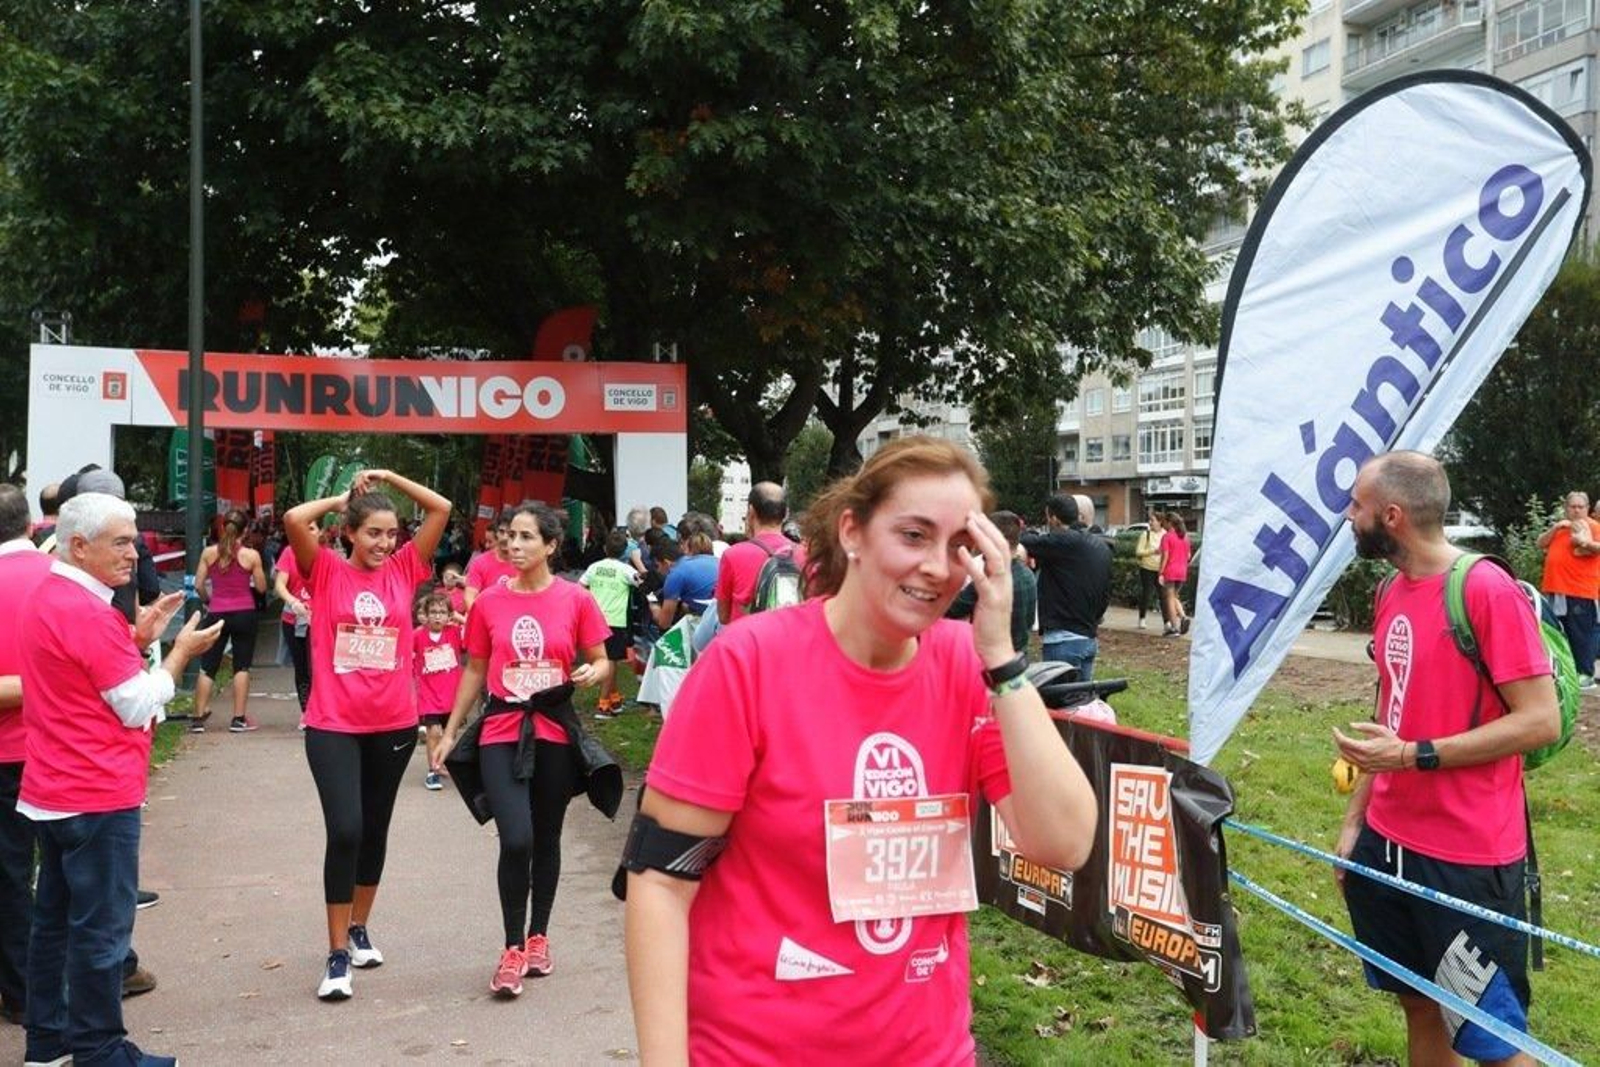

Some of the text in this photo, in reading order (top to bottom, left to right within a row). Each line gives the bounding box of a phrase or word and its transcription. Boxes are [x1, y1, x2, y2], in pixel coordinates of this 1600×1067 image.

[42, 373, 96, 385] CONCELLO
[48, 383, 90, 393] DE VIGO
[608, 387, 653, 399] CONCELLO
[613, 397, 649, 407] DE VIGO
[1208, 163, 1545, 680] Atlántico
[349, 638, 385, 655] 2442
[871, 747, 900, 769] VI
[865, 778, 918, 797] VIGO
[1116, 821, 1166, 866] THE
[864, 835, 940, 882] 3921
